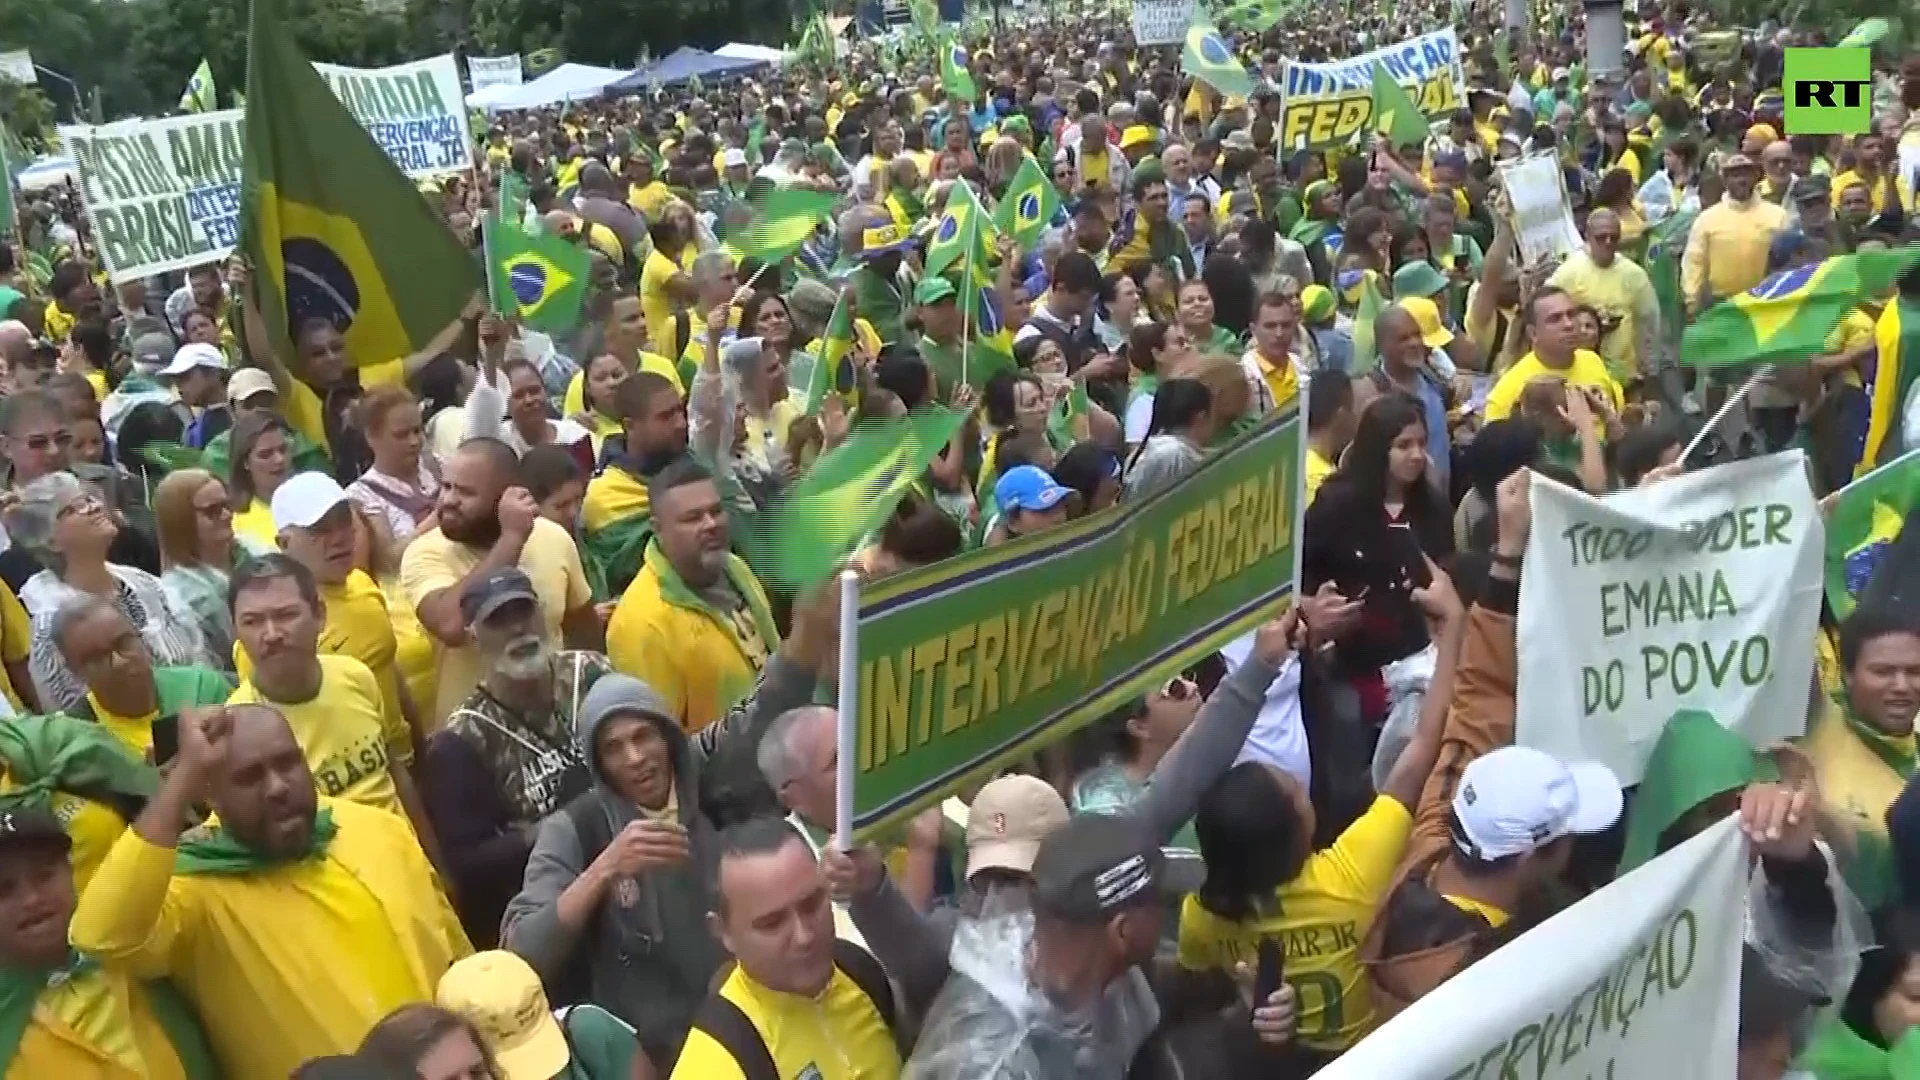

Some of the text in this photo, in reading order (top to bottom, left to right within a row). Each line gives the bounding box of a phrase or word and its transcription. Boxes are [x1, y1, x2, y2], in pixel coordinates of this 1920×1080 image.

[1284, 73, 1462, 149] FEDAL
[167, 119, 244, 190] AMA
[94, 196, 212, 272] BRASIL
[185, 179, 241, 221] INTER
[202, 215, 238, 250] FED
[860, 455, 1292, 774] INTERVENÇÃO FEDERAL
[1601, 569, 1737, 637] EMANA
[1581, 659, 1625, 716] DO
